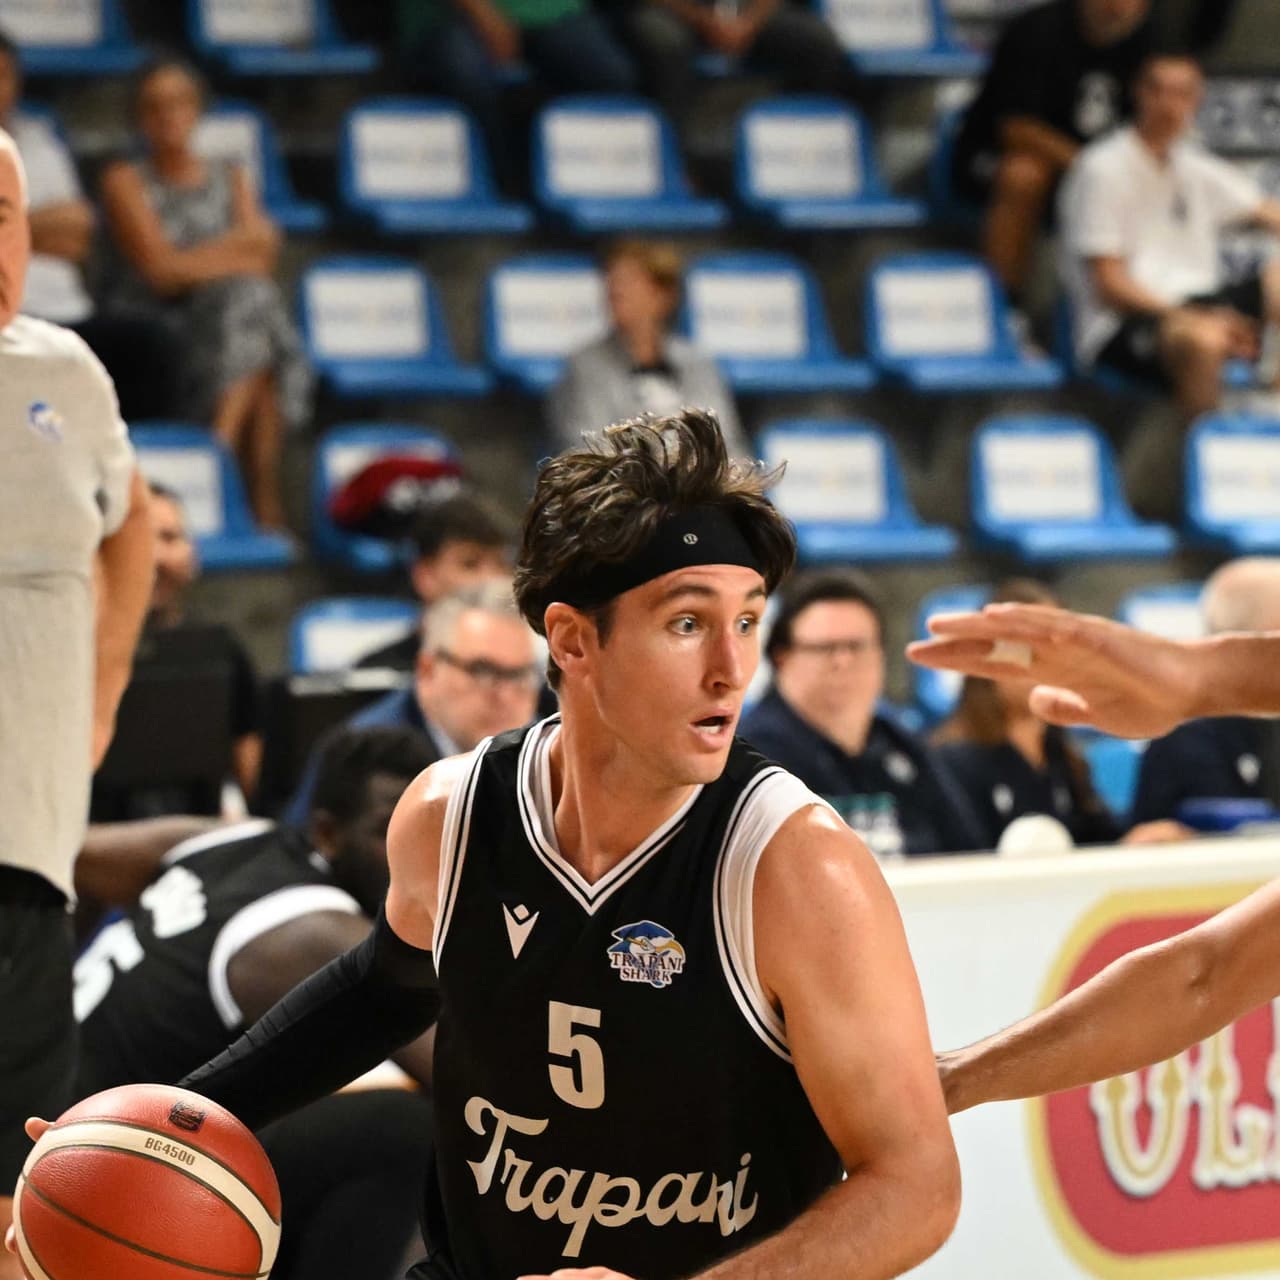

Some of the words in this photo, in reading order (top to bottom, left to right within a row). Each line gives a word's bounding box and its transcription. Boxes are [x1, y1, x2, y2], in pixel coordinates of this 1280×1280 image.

[612, 953, 682, 972] TRAPANI
[622, 967, 671, 982] SHARK
[548, 1001, 605, 1109] 5
[144, 1137, 196, 1166] BG4500
[464, 1096, 759, 1258] Trapani
